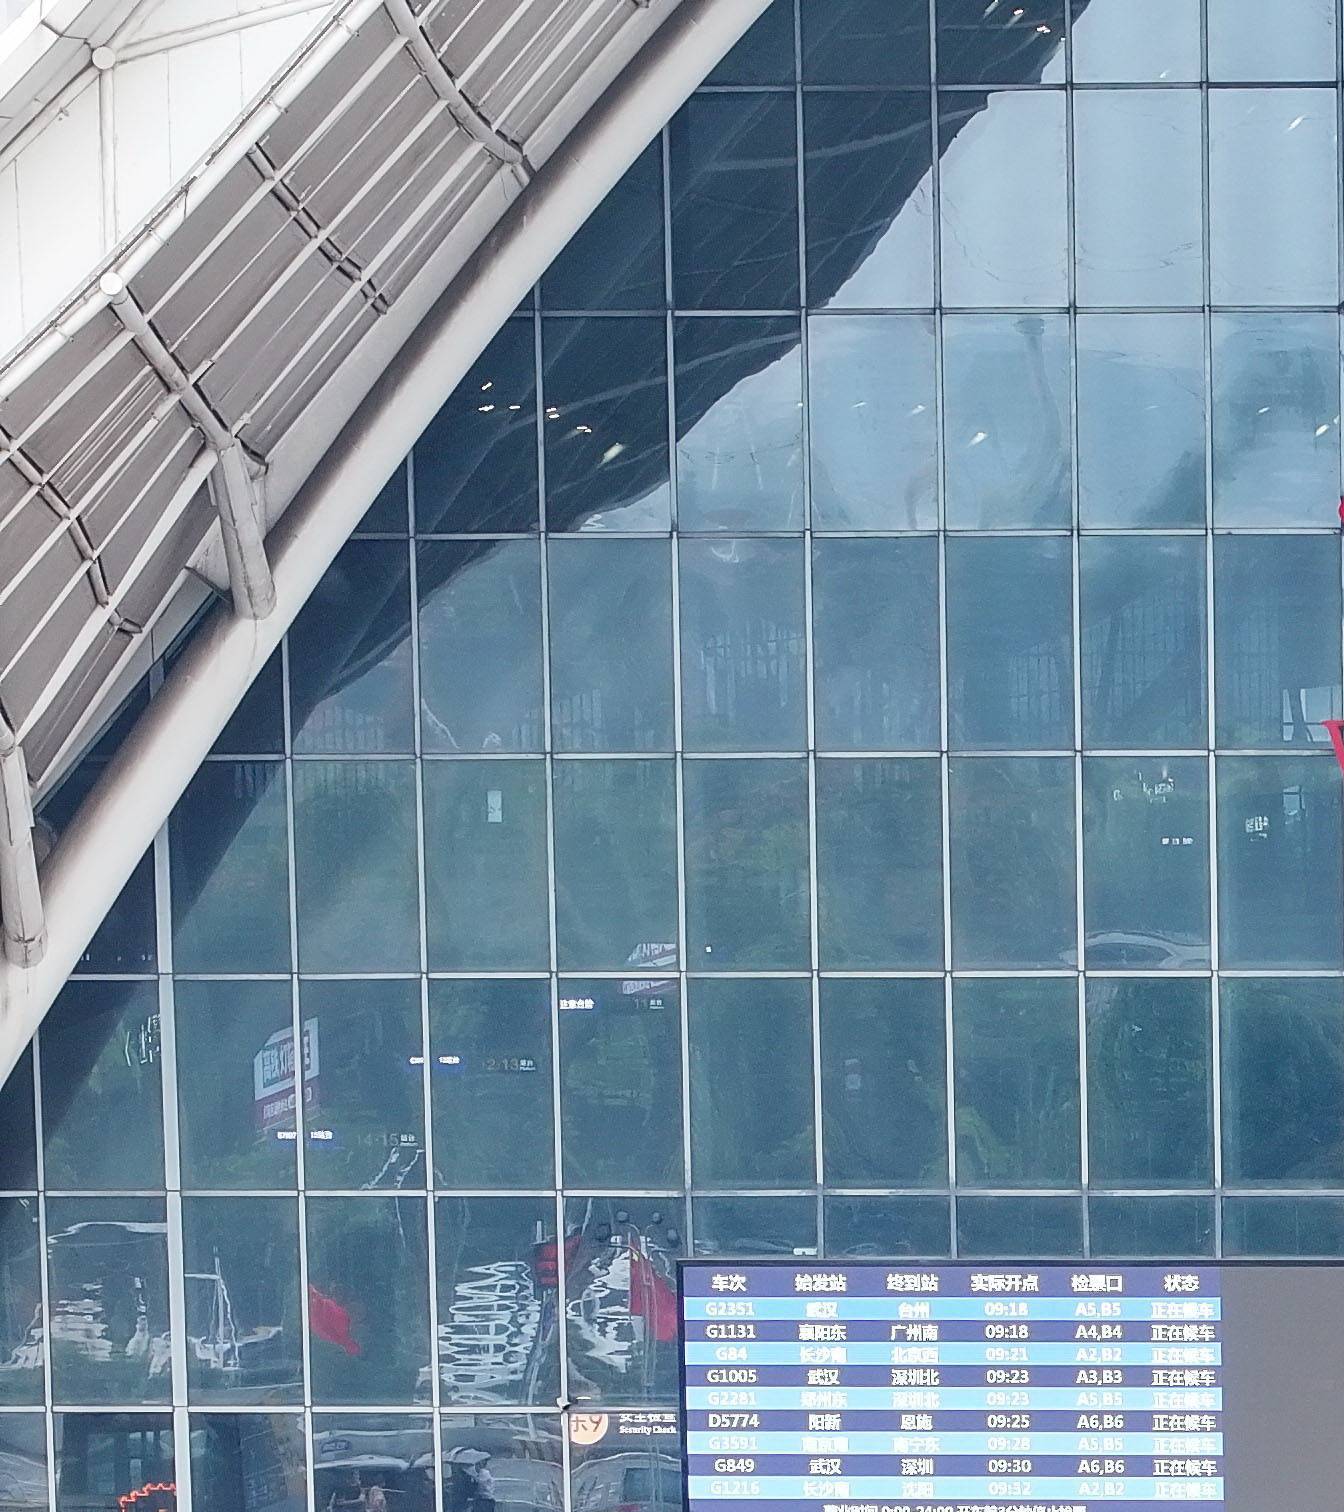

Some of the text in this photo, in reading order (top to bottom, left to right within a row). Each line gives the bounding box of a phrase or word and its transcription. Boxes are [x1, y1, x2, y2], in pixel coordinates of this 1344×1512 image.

[711, 1273, 1200, 1293] 车次 始发站 终到站 实际开点 检票口 状态
[705, 1324, 756, 1339] G1131
[890, 1323, 939, 1342] 广州南
[985, 1324, 1029, 1339] 09:18
[1074, 1324, 1123, 1341] A4,B4
[706, 1369, 757, 1383] G1005
[807, 1368, 841, 1386] 武汉
[891, 1368, 940, 1386] 深圳北
[986, 1369, 1030, 1384] 09:23
[1075, 1369, 1123, 1386] A3,B3
[708, 1413, 760, 1428] D5774
[808, 1413, 842, 1431] 阳新
[900, 1413, 933, 1431] 恩施
[987, 1414, 1030, 1429] 09:25
[1076, 1414, 1124, 1431] A6,B6
[714, 1458, 755, 1473] G849
[809, 1457, 842, 1475] 武汉
[900, 1457, 934, 1476] 深圳
[988, 1459, 1032, 1473] 09:30
[1077, 1459, 1125, 1476] A6,B6
